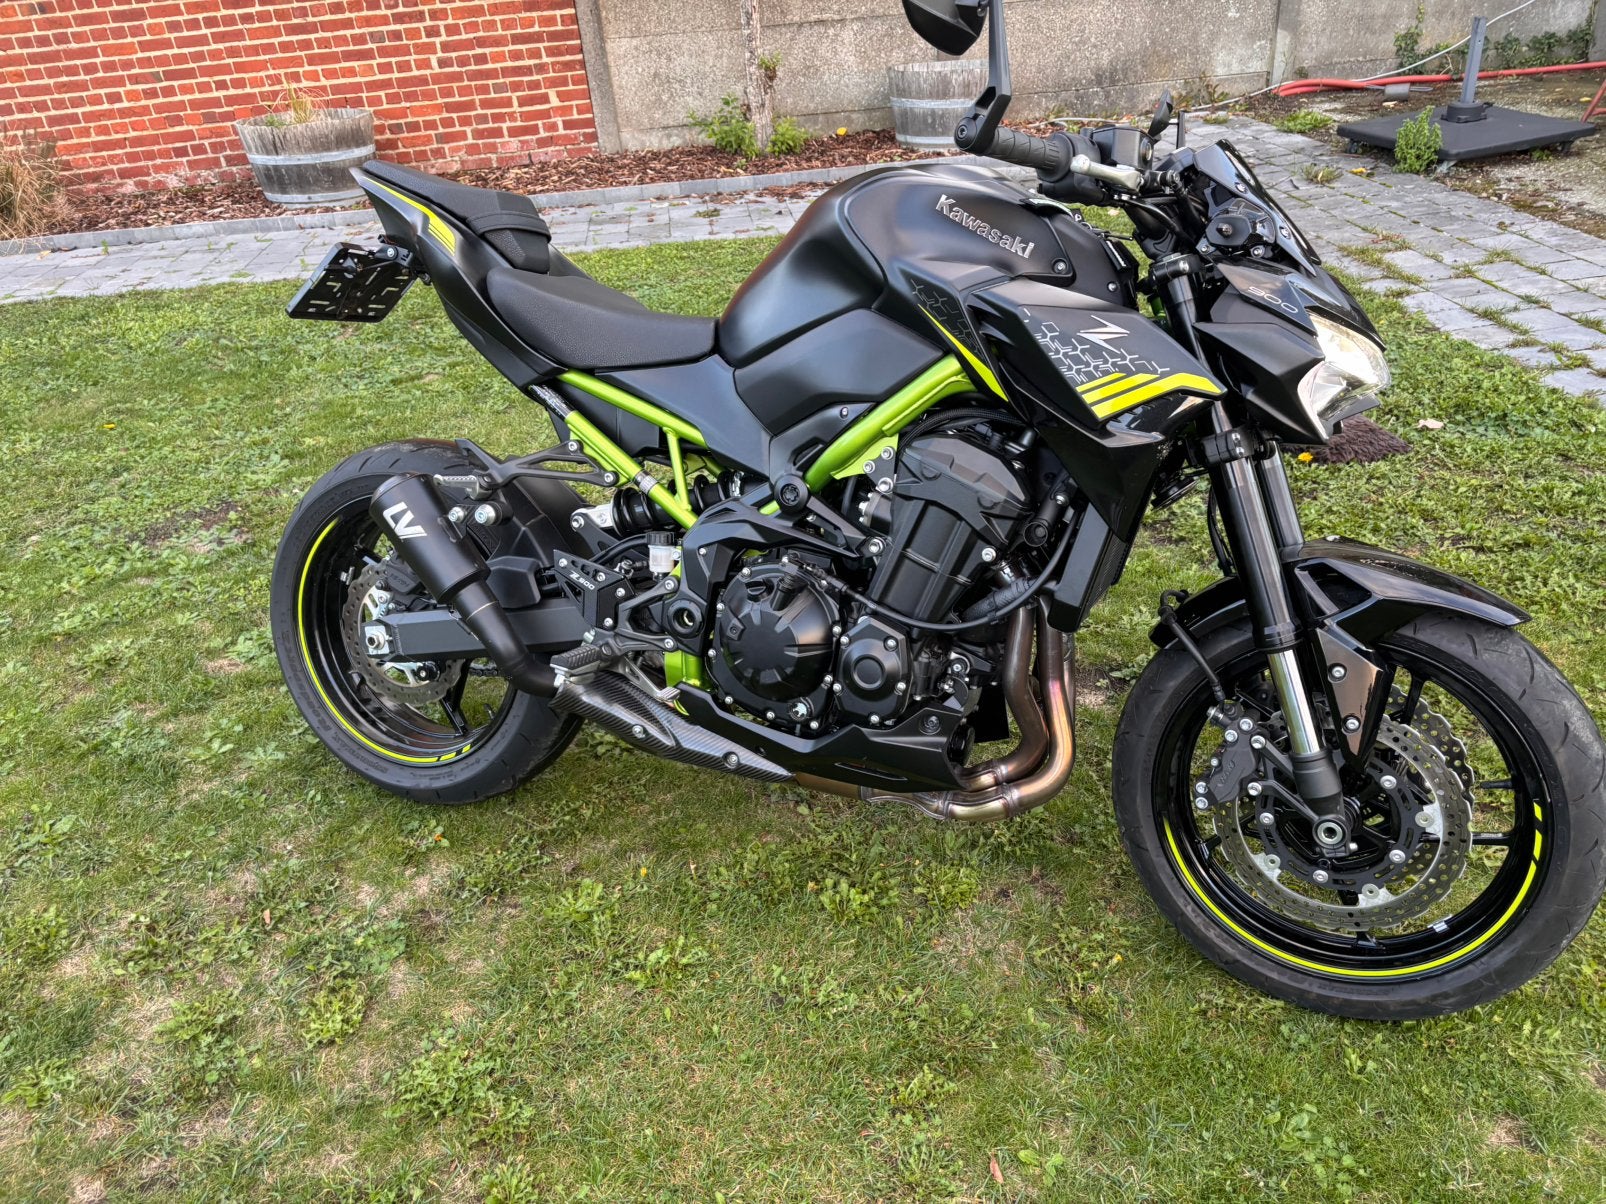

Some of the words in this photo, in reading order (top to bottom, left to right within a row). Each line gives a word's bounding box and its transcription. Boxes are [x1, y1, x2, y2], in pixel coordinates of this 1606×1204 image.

[936, 194, 1035, 259] Kawasaki
[1248, 286, 1299, 314] 900
[382, 501, 427, 539] LV
